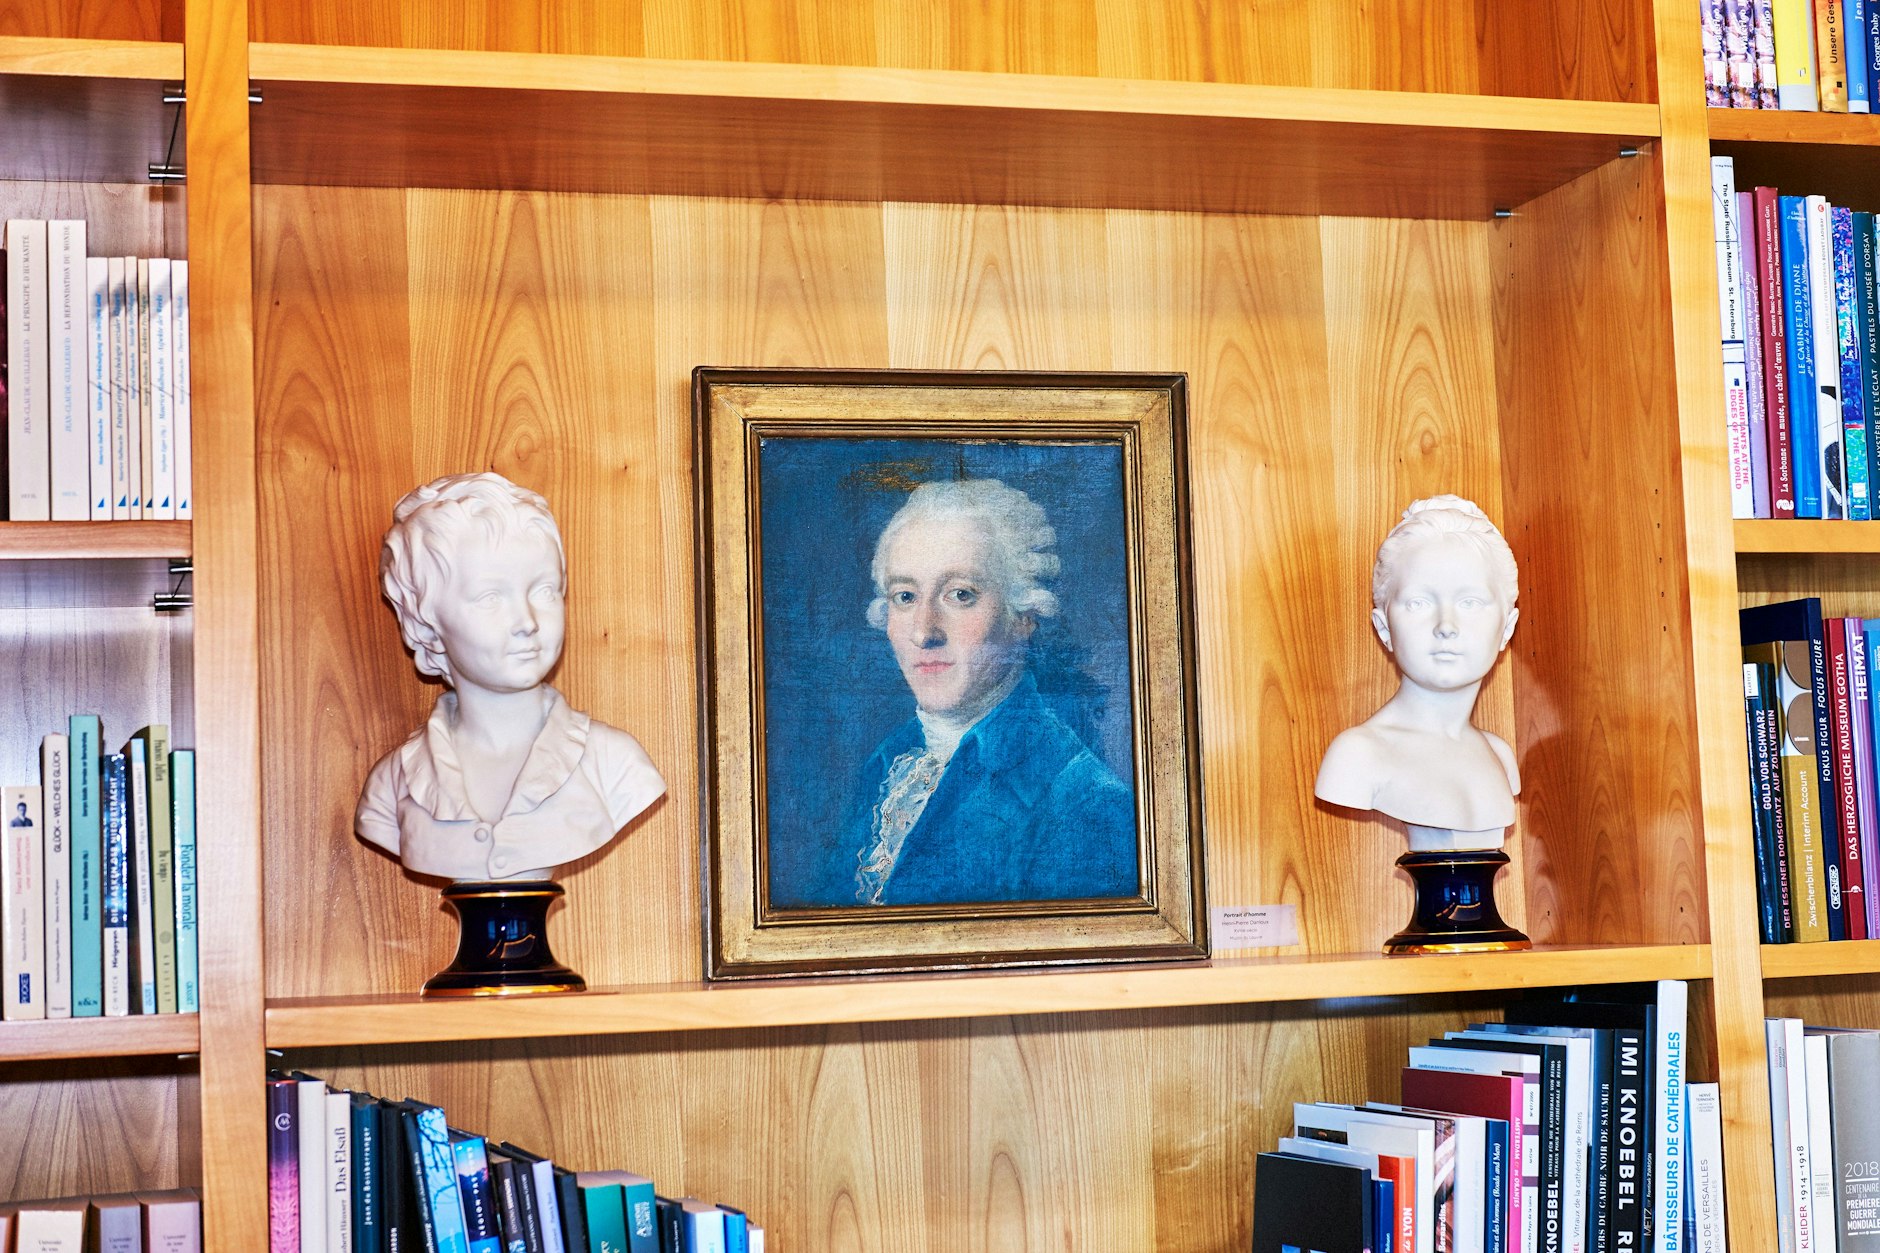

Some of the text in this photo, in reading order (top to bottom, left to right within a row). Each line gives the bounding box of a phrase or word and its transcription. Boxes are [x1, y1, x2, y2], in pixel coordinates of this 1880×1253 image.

[1829, 27, 1838, 64] Unsere
[1870, 12, 1880, 71] Georges Duby
[21, 234, 30, 282] D'HUMANITÉ
[63, 255, 70, 265] DU
[1722, 183, 1730, 198] The
[1727, 299, 1736, 340] Petersburg
[1863, 232, 1872, 268] D'ORSAY
[63, 267, 71, 318] REFONDATION
[1864, 271, 1873, 299] MUSÉE
[64, 320, 71, 330] LA
[1793, 264, 1806, 374] LE CABINET DE DIANE
[1867, 302, 1874, 315] DU
[23, 323, 30, 332] LE
[1867, 318, 1876, 353] PASTELS
[1748, 336, 1756, 360] National
[1774, 341, 1784, 391] chefs-d'œuvre
[1750, 371, 1758, 403] Beaux-Arts
[1871, 369, 1880, 402] L'ÉCLAT
[23, 387, 31, 434] JEAN-CLAUDE
[1730, 389, 1738, 419] EDGES
[1777, 405, 1787, 430] musée,
[1873, 406, 1880, 416] ET
[1732, 421, 1739, 431] OF
[1737, 389, 1750, 485] INHABITANTS AT THE
[1779, 431, 1786, 441] un
[1734, 456, 1743, 490] WORLD
[1779, 448, 1789, 482] Sorbonne
[1780, 483, 1789, 493] La
[1852, 632, 1868, 701] HEIMAT
[1813, 639, 1831, 782] FOKUS FIGUR FOCUS FIGURE
[1768, 709, 1778, 770] ZOLLVEREIN
[1835, 653, 1858, 860] DAS HERZOGLICHE MUSEUM GOTHA
[1756, 709, 1772, 810] GOLD VOR SCHWARZ
[52, 750, 62, 853] GLÜCK WELCHES GLÜCK
[109, 776, 118, 844] NIEDERTRACHT
[1775, 797, 1786, 857] DOMSCHATZ
[1799, 770, 1818, 928] Zwischenbilanz Interim Account
[181, 844, 195, 931] Fonder la morale
[1780, 860, 1789, 906] ESSENER
[110, 910, 119, 923] DIE
[1783, 908, 1791, 929] DER
[111, 930, 121, 968] Hirigoyen
[1621, 1037, 1638, 1076] IMI
[1601, 1083, 1609, 1126] SAUMUR
[333, 1127, 346, 1163] Elsaß
[1493, 1142, 1501, 1161] Men)
[1600, 1129, 1608, 1143] DE
[1618, 1088, 1637, 1210] KNOEBEL
[1663, 1031, 1680, 1251] BÂTISSEURS DE CATHÉDRALES
[363, 1126, 373, 1226] Jean du Boisberranger
[1492, 1162, 1500, 1174] and
[1573, 1111, 1583, 1238] Vitraux de la cathédrale de Reims
[1600, 1146, 1608, 1171] NOIR
[1844, 1161, 1880, 1178] 2018
[335, 1167, 346, 1193] Das
[1492, 1175, 1501, 1198] (Roads
[1599, 1174, 1607, 1209] CADRE
[1700, 1159, 1710, 1220] VERSAILLES
[1845, 1182, 1880, 1194] CENTENAIRE
[1492, 1199, 1500, 1224] hommes
[1546, 1180, 1559, 1253] KNOEBEL
[1711, 1179, 1719, 1221] VERSAILLES
[1850, 1209, 1877, 1219] GUERRE
[1402, 1207, 1413, 1237] LYON
[1438, 1203, 1448, 1252] Bernardins
[1492, 1224, 1500, 1234] des
[1598, 1212, 1606, 1226] DU
[1643, 1208, 1652, 1237] METZ
[1703, 1223, 1711, 1237] DE
[1712, 1223, 1720, 1233] OF
[1799, 1204, 1809, 1250] KLEIDER
[1847, 1219, 1880, 1230] MONDIALE
